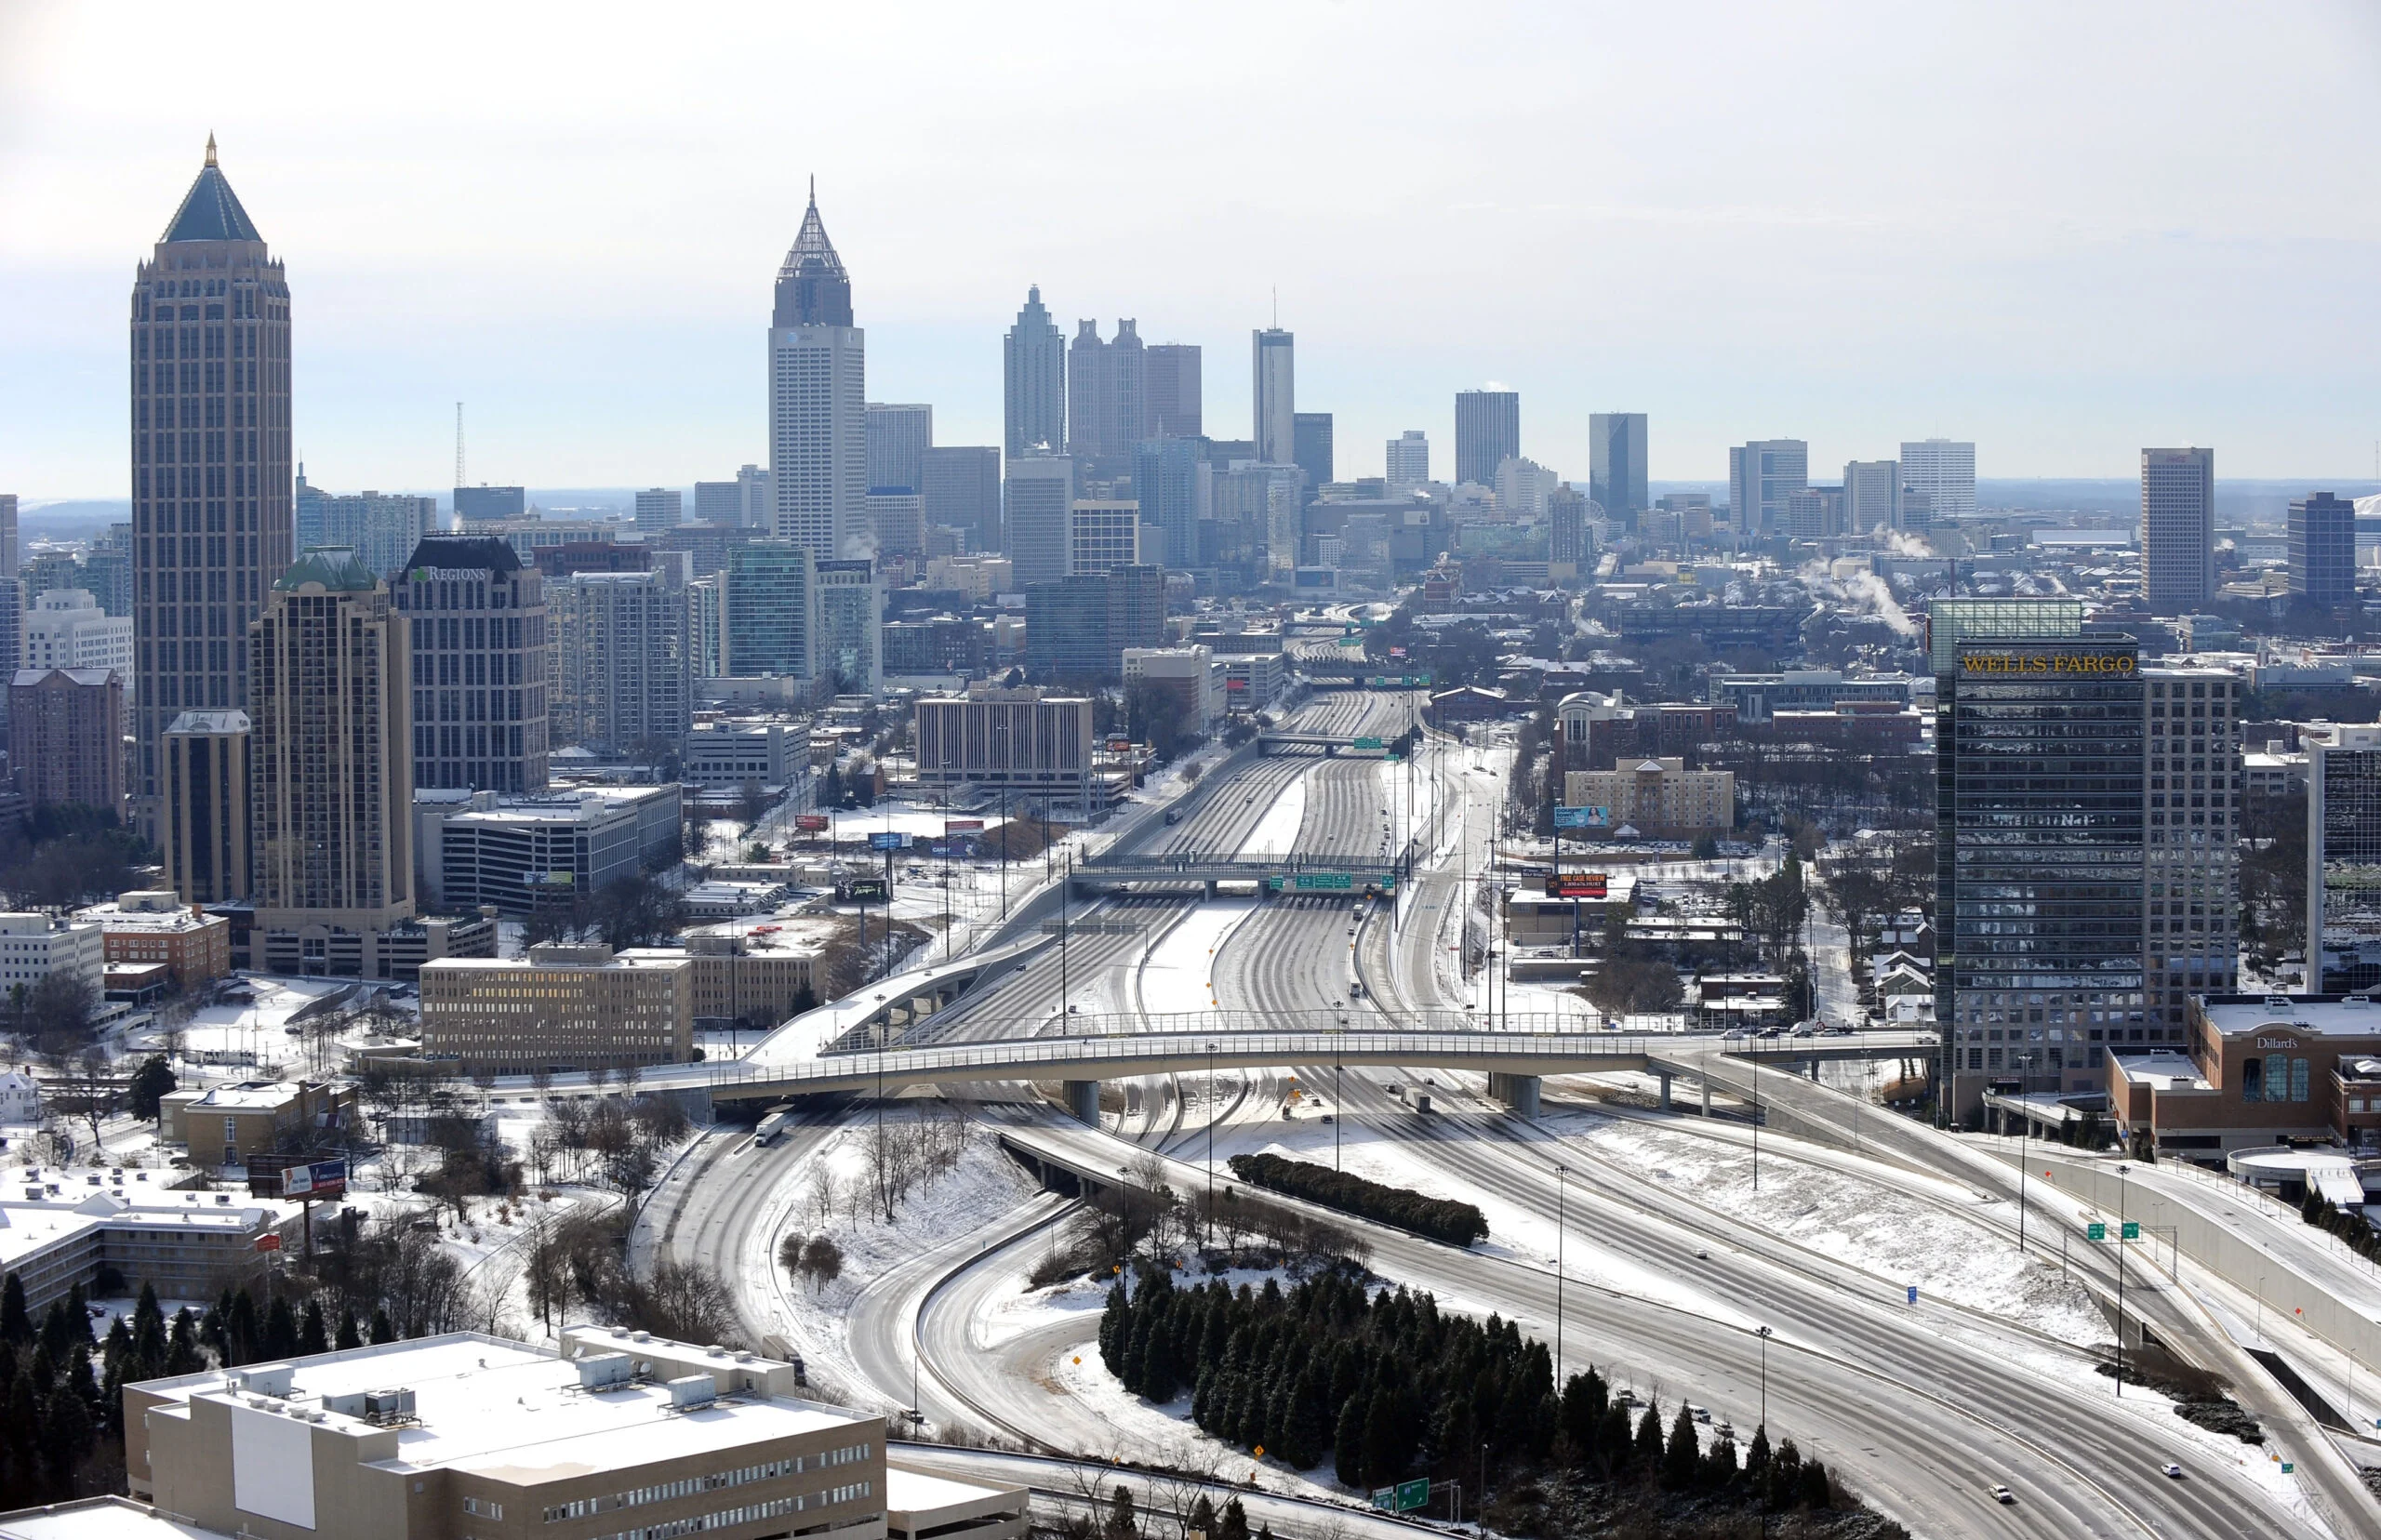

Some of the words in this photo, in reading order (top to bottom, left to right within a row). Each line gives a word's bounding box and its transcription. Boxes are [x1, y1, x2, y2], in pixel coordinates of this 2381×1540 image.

[429, 565, 486, 580] REGIONS
[1962, 657, 2046, 672] WELLS
[2053, 657, 2135, 672] FARGO
[2256, 1037, 2298, 1049] Dillard's
